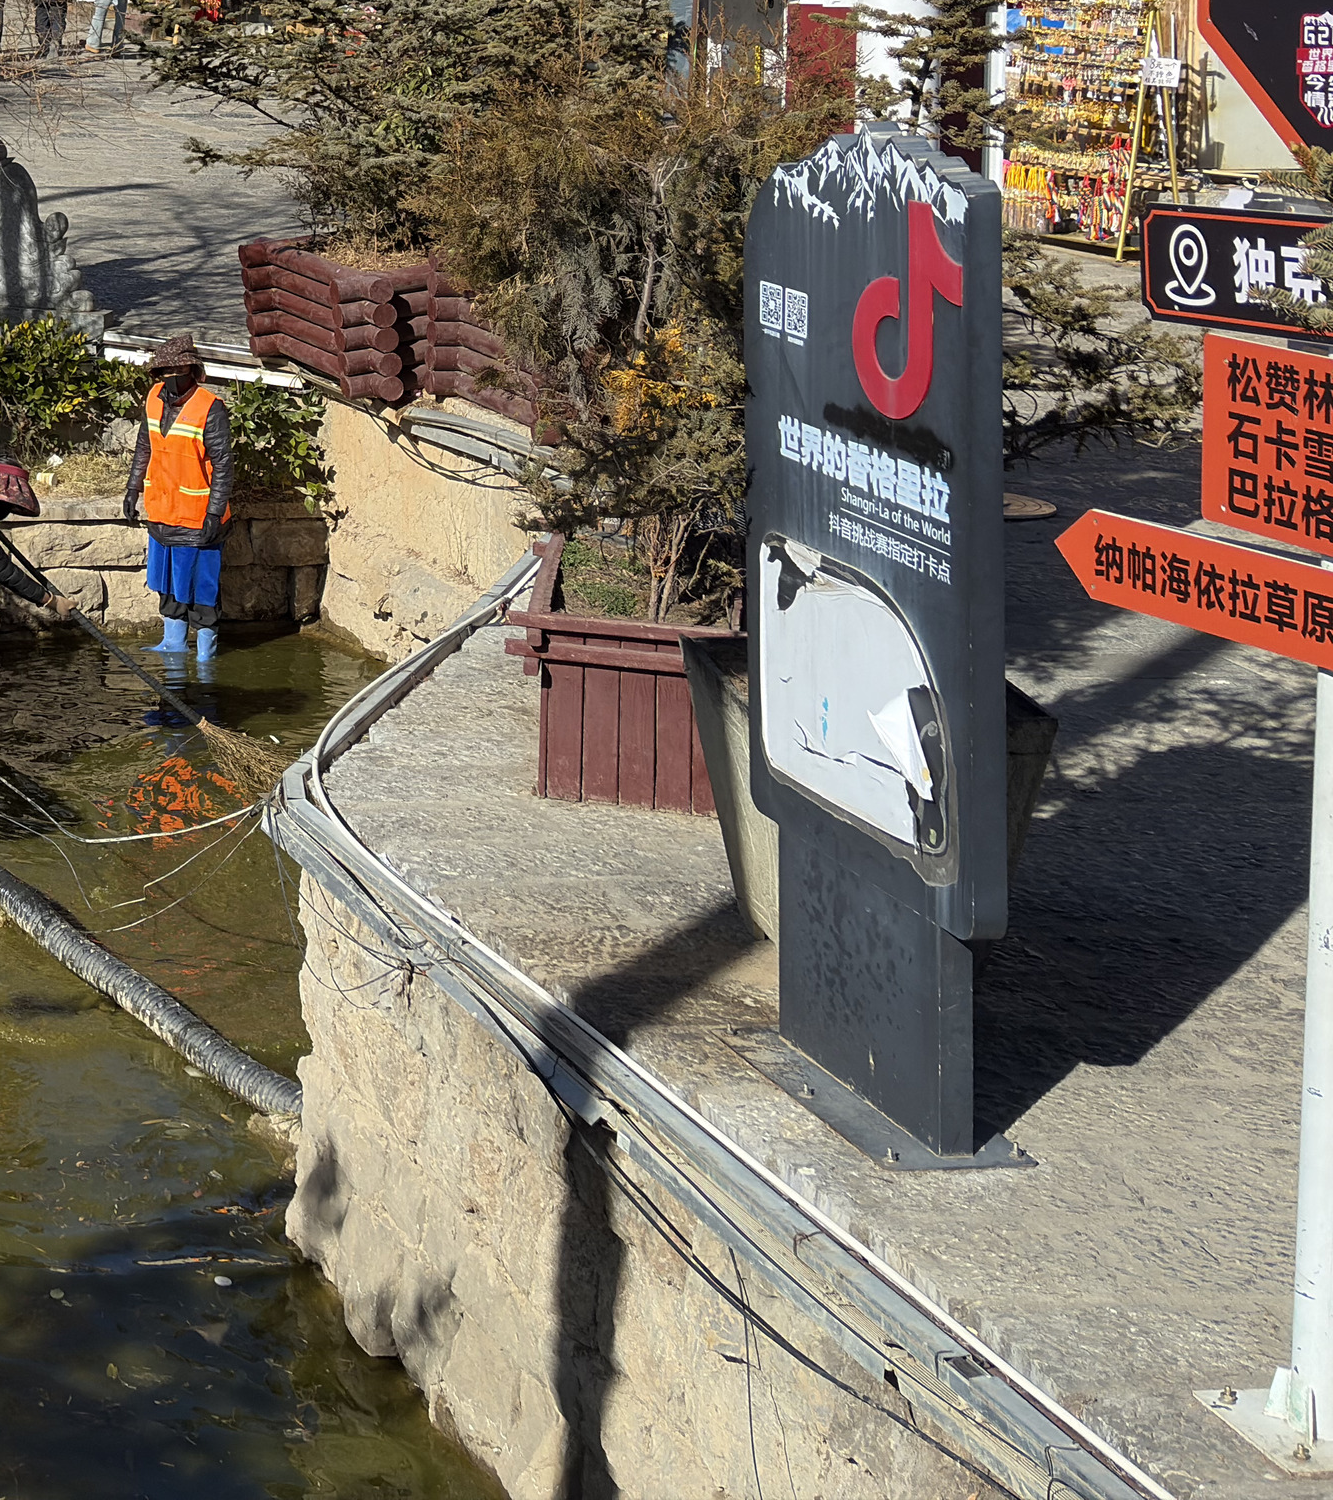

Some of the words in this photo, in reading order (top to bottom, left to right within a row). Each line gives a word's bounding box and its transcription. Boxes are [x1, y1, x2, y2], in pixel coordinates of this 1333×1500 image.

[1304, 26, 1333, 45] G2
[1227, 353, 1333, 424] 松赞林
[778, 414, 951, 524] 世界的香格里拉
[1227, 411, 1333, 484] 石卡雪
[840, 486, 890, 520] Shangri-La
[891, 510, 902, 526] of
[903, 514, 920, 531] the
[920, 519, 951, 546] World
[1227, 467, 1333, 543] 巴拉格
[828, 511, 951, 586] 抖音挑战赛指定打卡点
[1093, 533, 1333, 645] 纳帕海依拉草原
